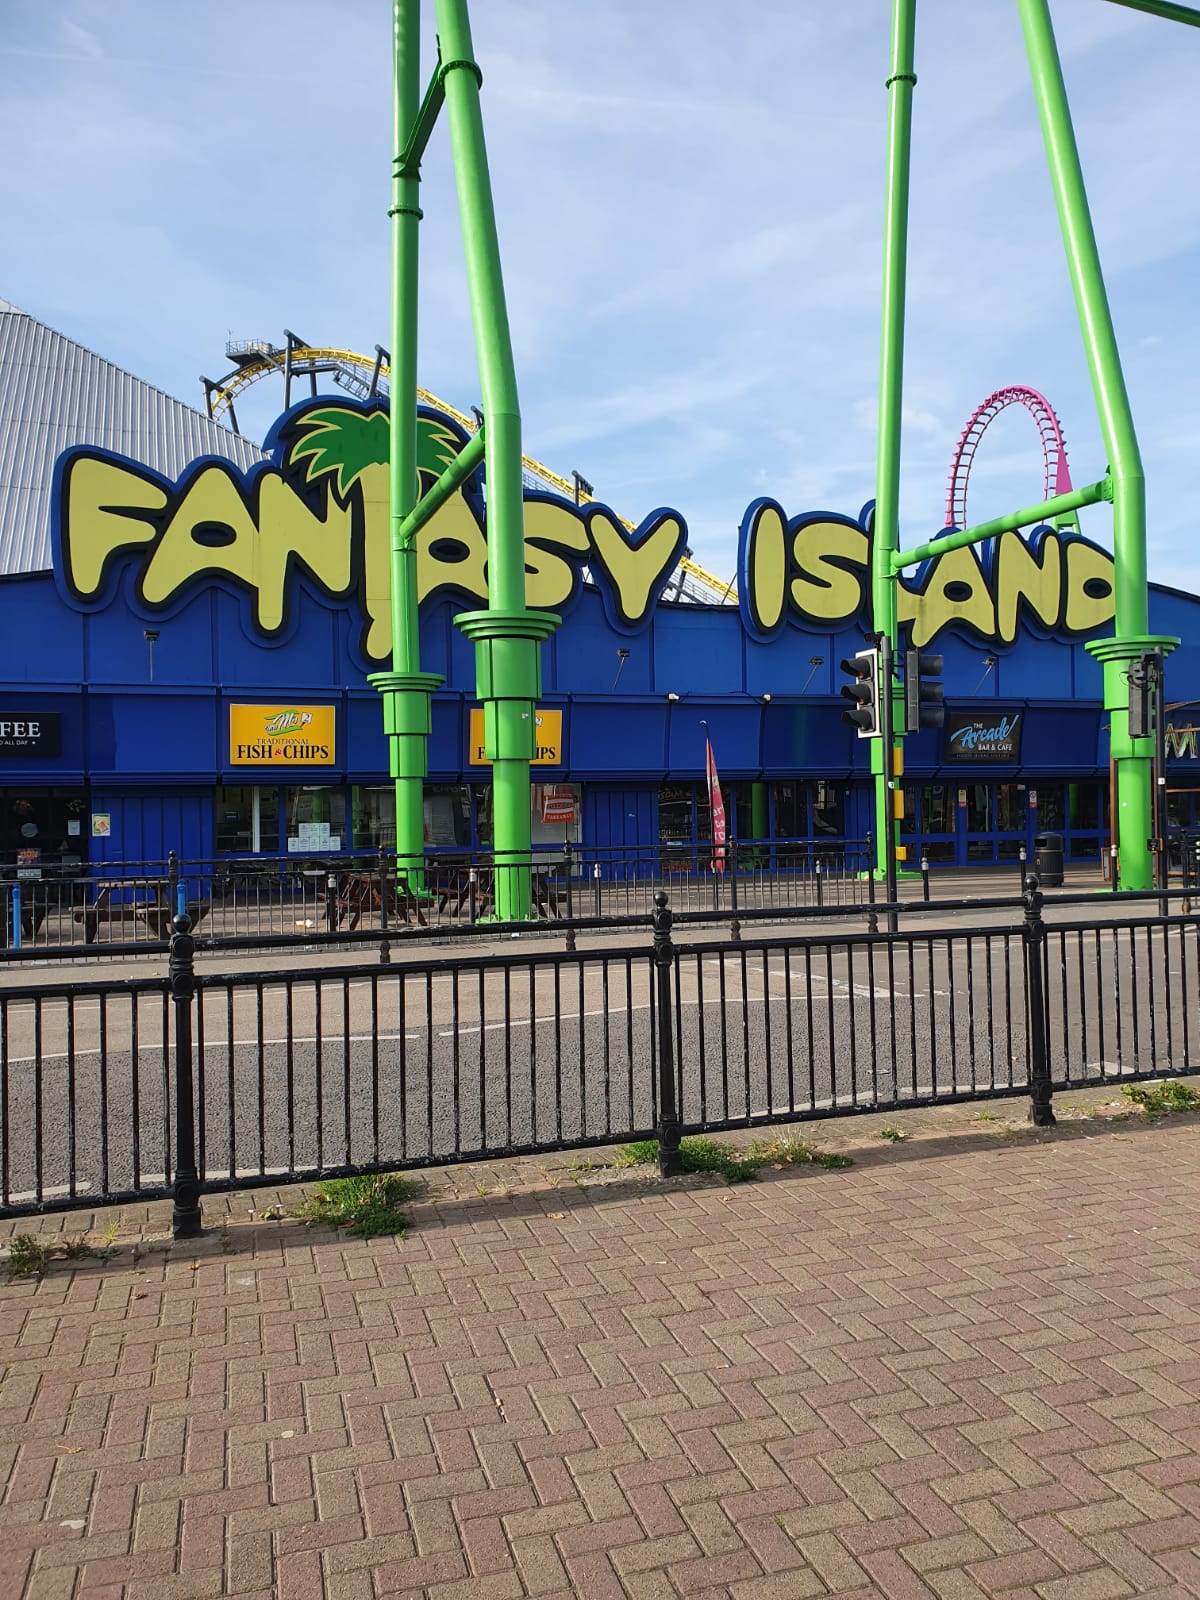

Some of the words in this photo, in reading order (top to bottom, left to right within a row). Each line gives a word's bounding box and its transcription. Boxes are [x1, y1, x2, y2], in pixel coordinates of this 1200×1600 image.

[750, 502, 1117, 650] ISAND
[0, 721, 41, 737] FEE
[950, 715, 1019, 749] Arcade
[237, 745, 273, 759] FISH
[275, 748, 282, 756] &
[283, 745, 329, 759] CHIPS
